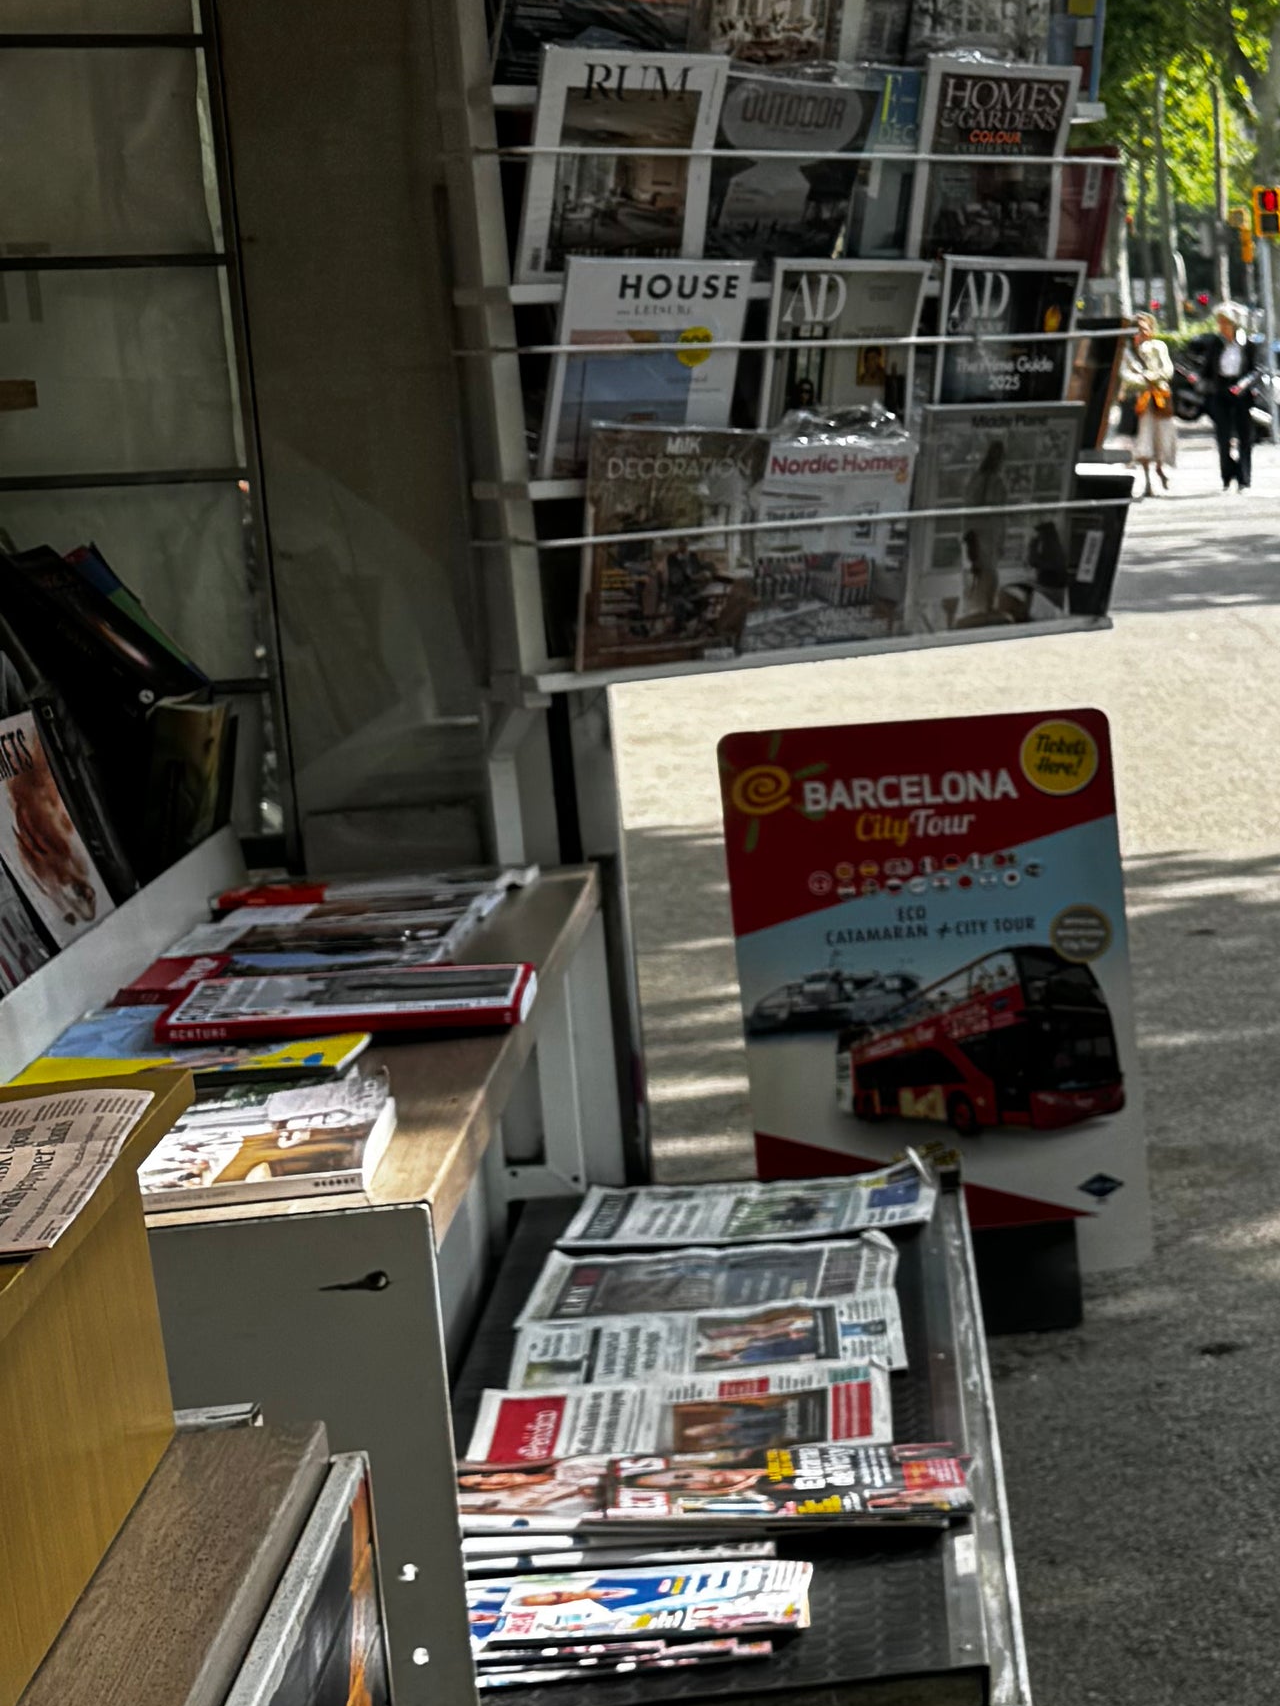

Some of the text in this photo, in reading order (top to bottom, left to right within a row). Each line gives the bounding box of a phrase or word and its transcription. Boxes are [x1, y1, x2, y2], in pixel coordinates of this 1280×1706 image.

[585, 63, 692, 102] RUM
[945, 77, 1064, 112] HOMES
[741, 91, 847, 131] OUTDOOR
[958, 110, 1057, 131] GARDENS
[968, 129, 1022, 145] COLOUR
[618, 274, 740, 300] HOUSE
[782, 272, 847, 323] AD
[950, 270, 1011, 319] AD
[1016, 355, 1054, 372] Guide
[607, 456, 753, 479] DECORATION
[770, 453, 838, 475] Nordic
[802, 766, 1020, 813] BARCELONA
[897, 904, 927, 923] ECO
[825, 923, 929, 946] CATAMARAN
[955, 919, 988, 936] CITY
[993, 916, 1035, 933] TOUR
